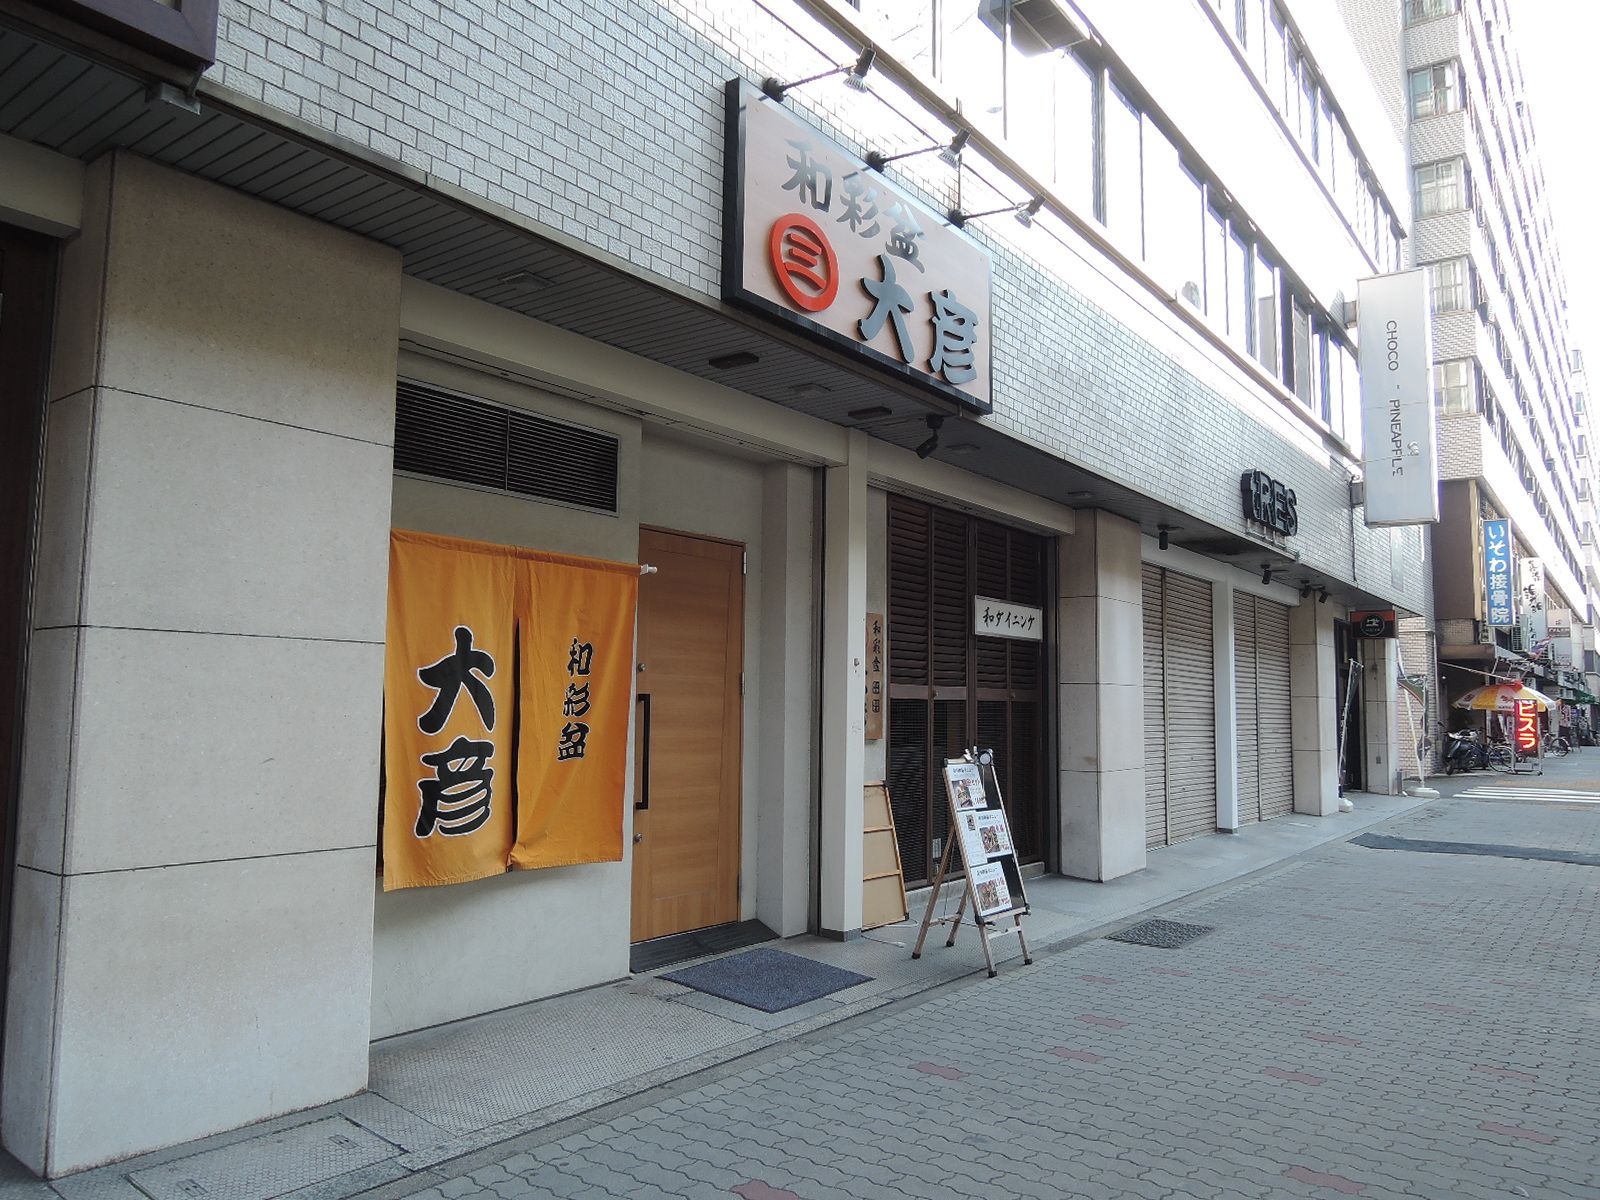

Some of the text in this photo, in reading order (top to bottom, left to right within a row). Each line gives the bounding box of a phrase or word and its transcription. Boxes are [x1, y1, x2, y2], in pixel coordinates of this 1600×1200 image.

[857, 254, 978, 384] 大彦
[1385, 319, 1399, 372] CHOCO
[1488, 524, 1509, 623] いそわ接骨院
[414, 625, 496, 838] 大彦
